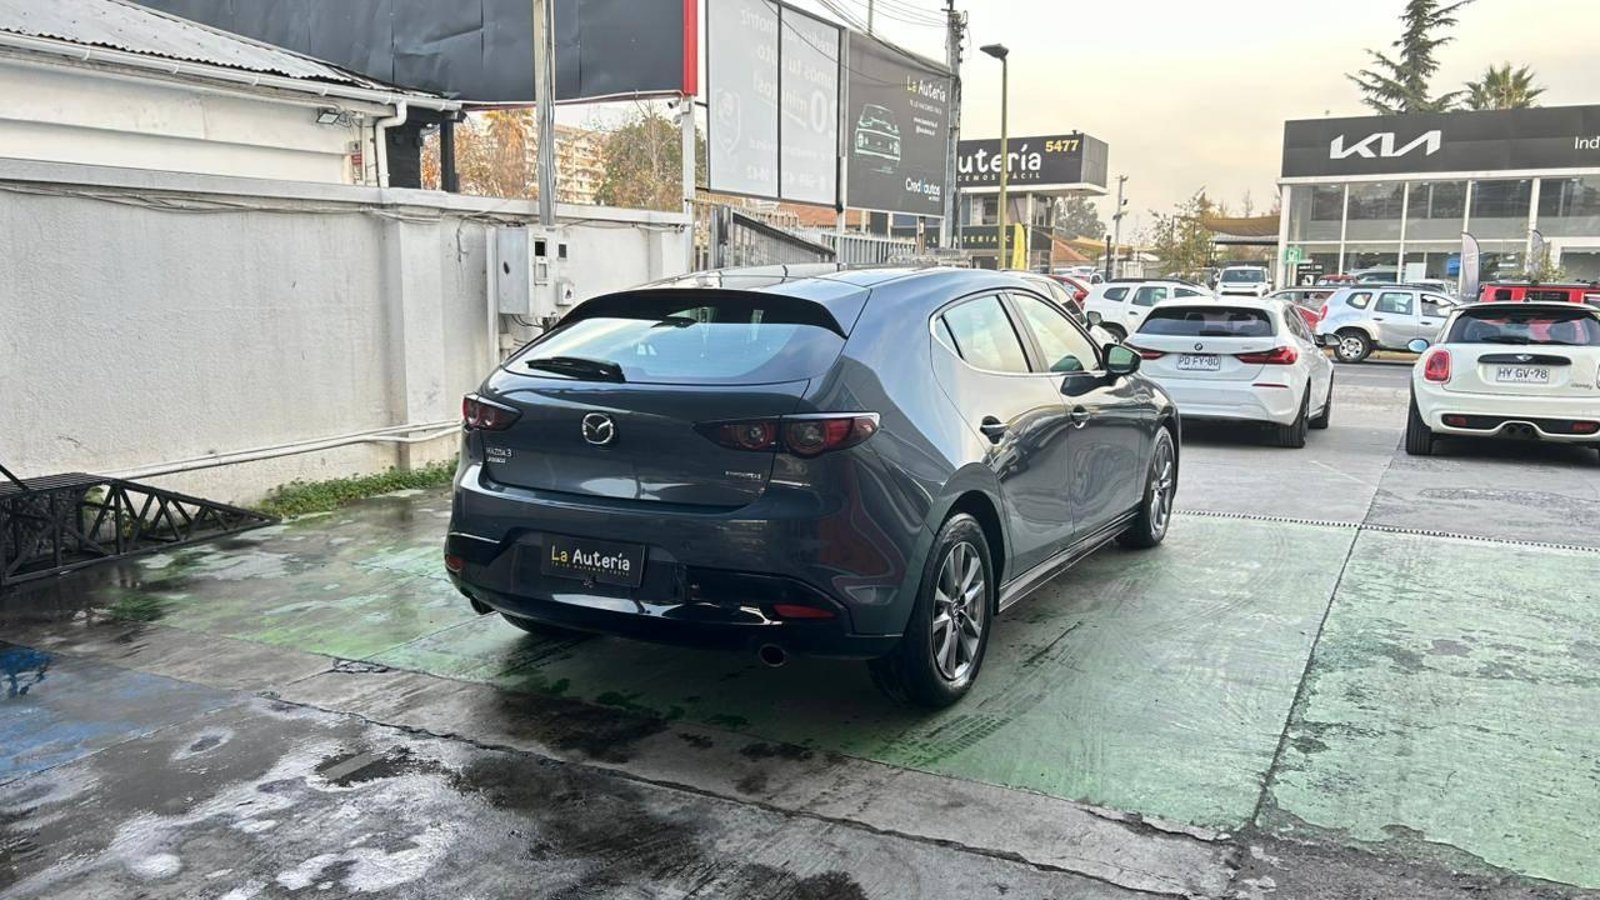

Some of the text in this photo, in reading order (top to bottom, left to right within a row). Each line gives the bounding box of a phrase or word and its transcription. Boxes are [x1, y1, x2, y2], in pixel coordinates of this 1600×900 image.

[1045, 140, 1079, 152] 5477
[1330, 130, 1442, 159] KIA
[1574, 136, 1600, 150] Ind
[959, 144, 1042, 173] utería
[1499, 367, 1512, 377] HY
[551, 545, 568, 562] La
[572, 548, 630, 571] Autería
